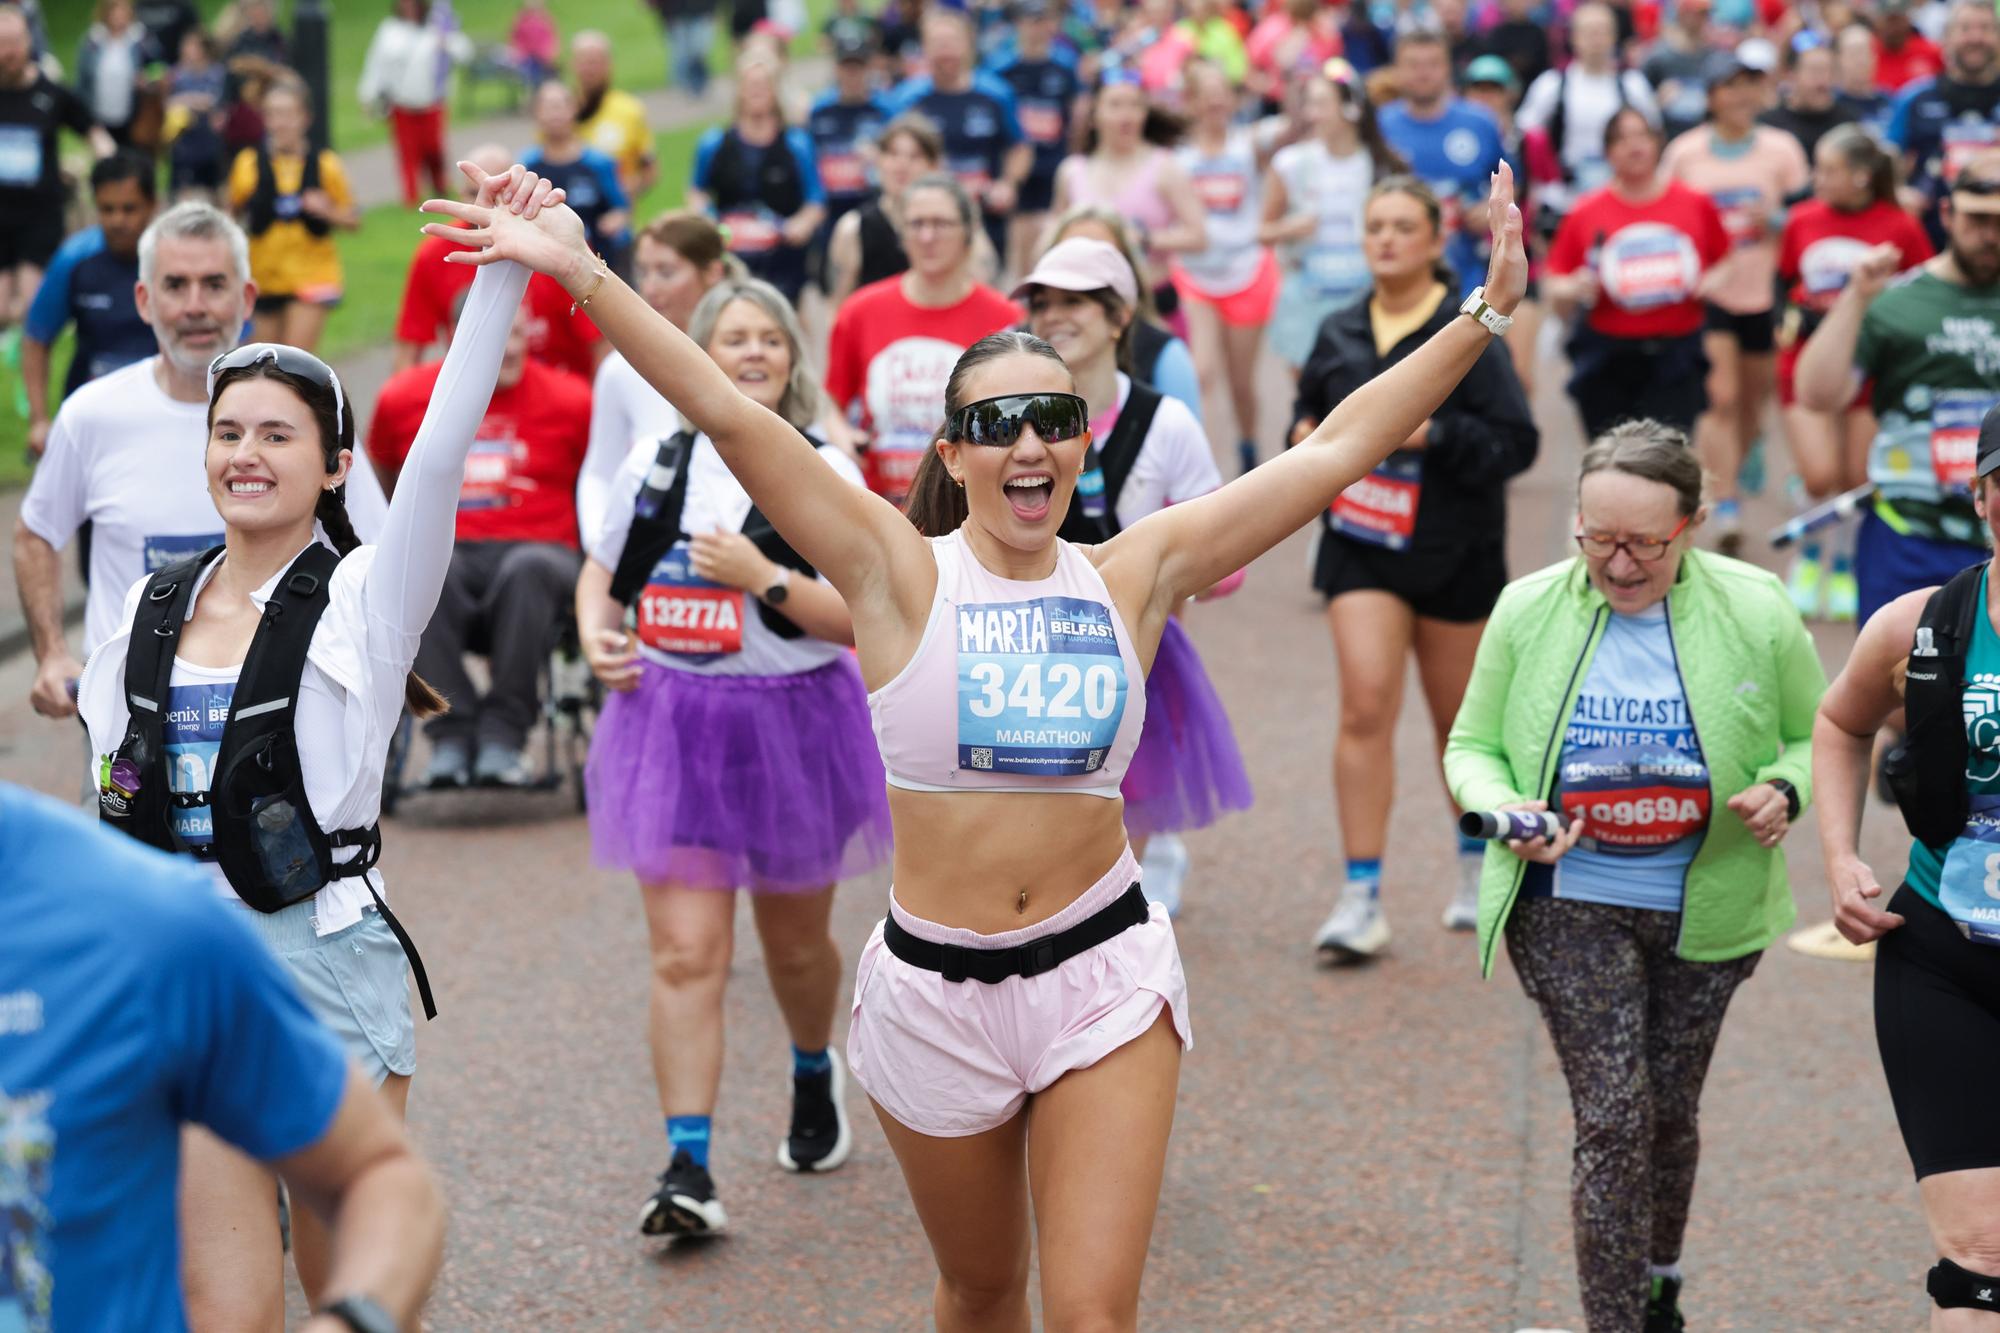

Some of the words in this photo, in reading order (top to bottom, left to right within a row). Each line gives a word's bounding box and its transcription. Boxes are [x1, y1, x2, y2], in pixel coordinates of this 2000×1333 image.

[642, 596, 738, 631] 13277A
[959, 606, 1048, 654] MARIA
[1051, 621, 1113, 638] BELFAST
[969, 663, 1117, 719] 3420
[177, 723, 200, 732] Energy
[996, 730, 1092, 745] MARATHON
[998, 756, 1086, 765] www.belfastcitymarathon.com
[1593, 829, 1634, 844] TEAM
